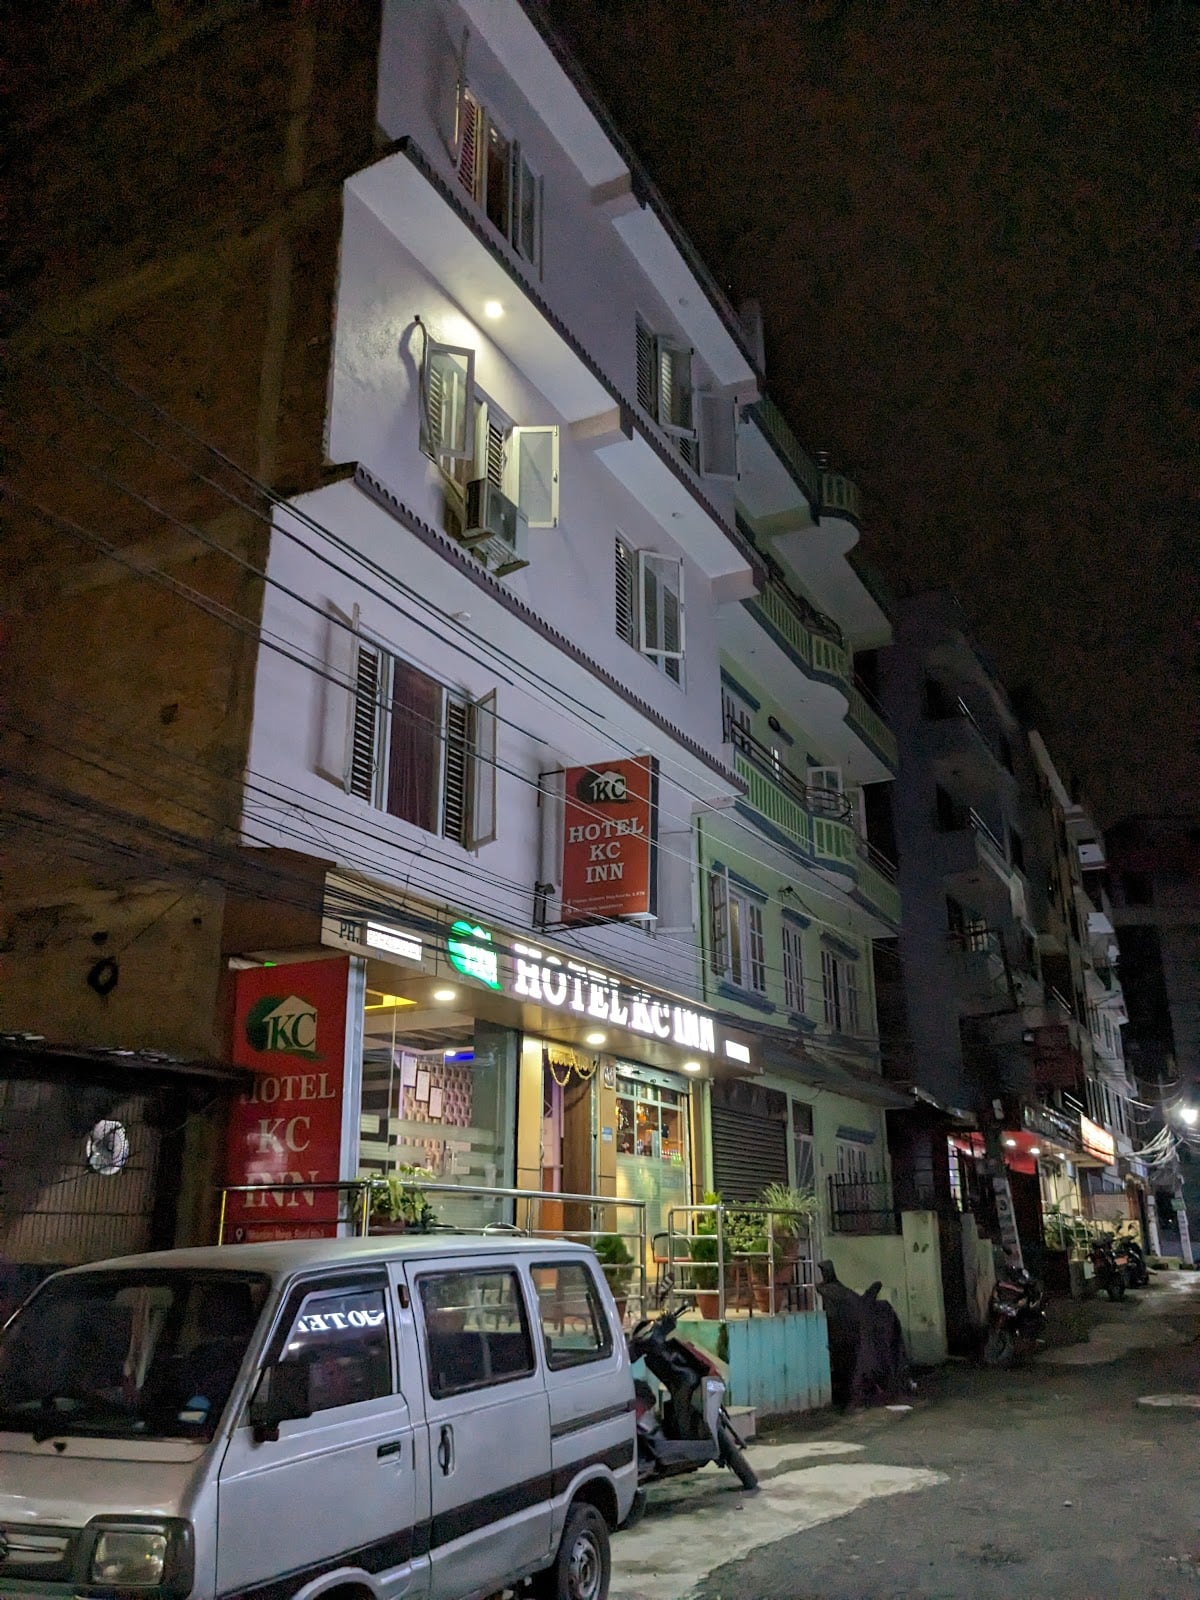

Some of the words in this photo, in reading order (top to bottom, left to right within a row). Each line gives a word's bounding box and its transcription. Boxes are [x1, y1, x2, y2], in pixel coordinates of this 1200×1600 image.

[596, 778, 626, 800] KC
[568, 816, 645, 843] HOTEL
[589, 842, 621, 861] KC
[585, 862, 624, 884] INN
[513, 943, 629, 1025] HOTEL
[673, 1005, 715, 1054] INN
[270, 1011, 317, 1049] KC
[256, 1116, 311, 1154] KC
[242, 1170, 319, 1208] INN
